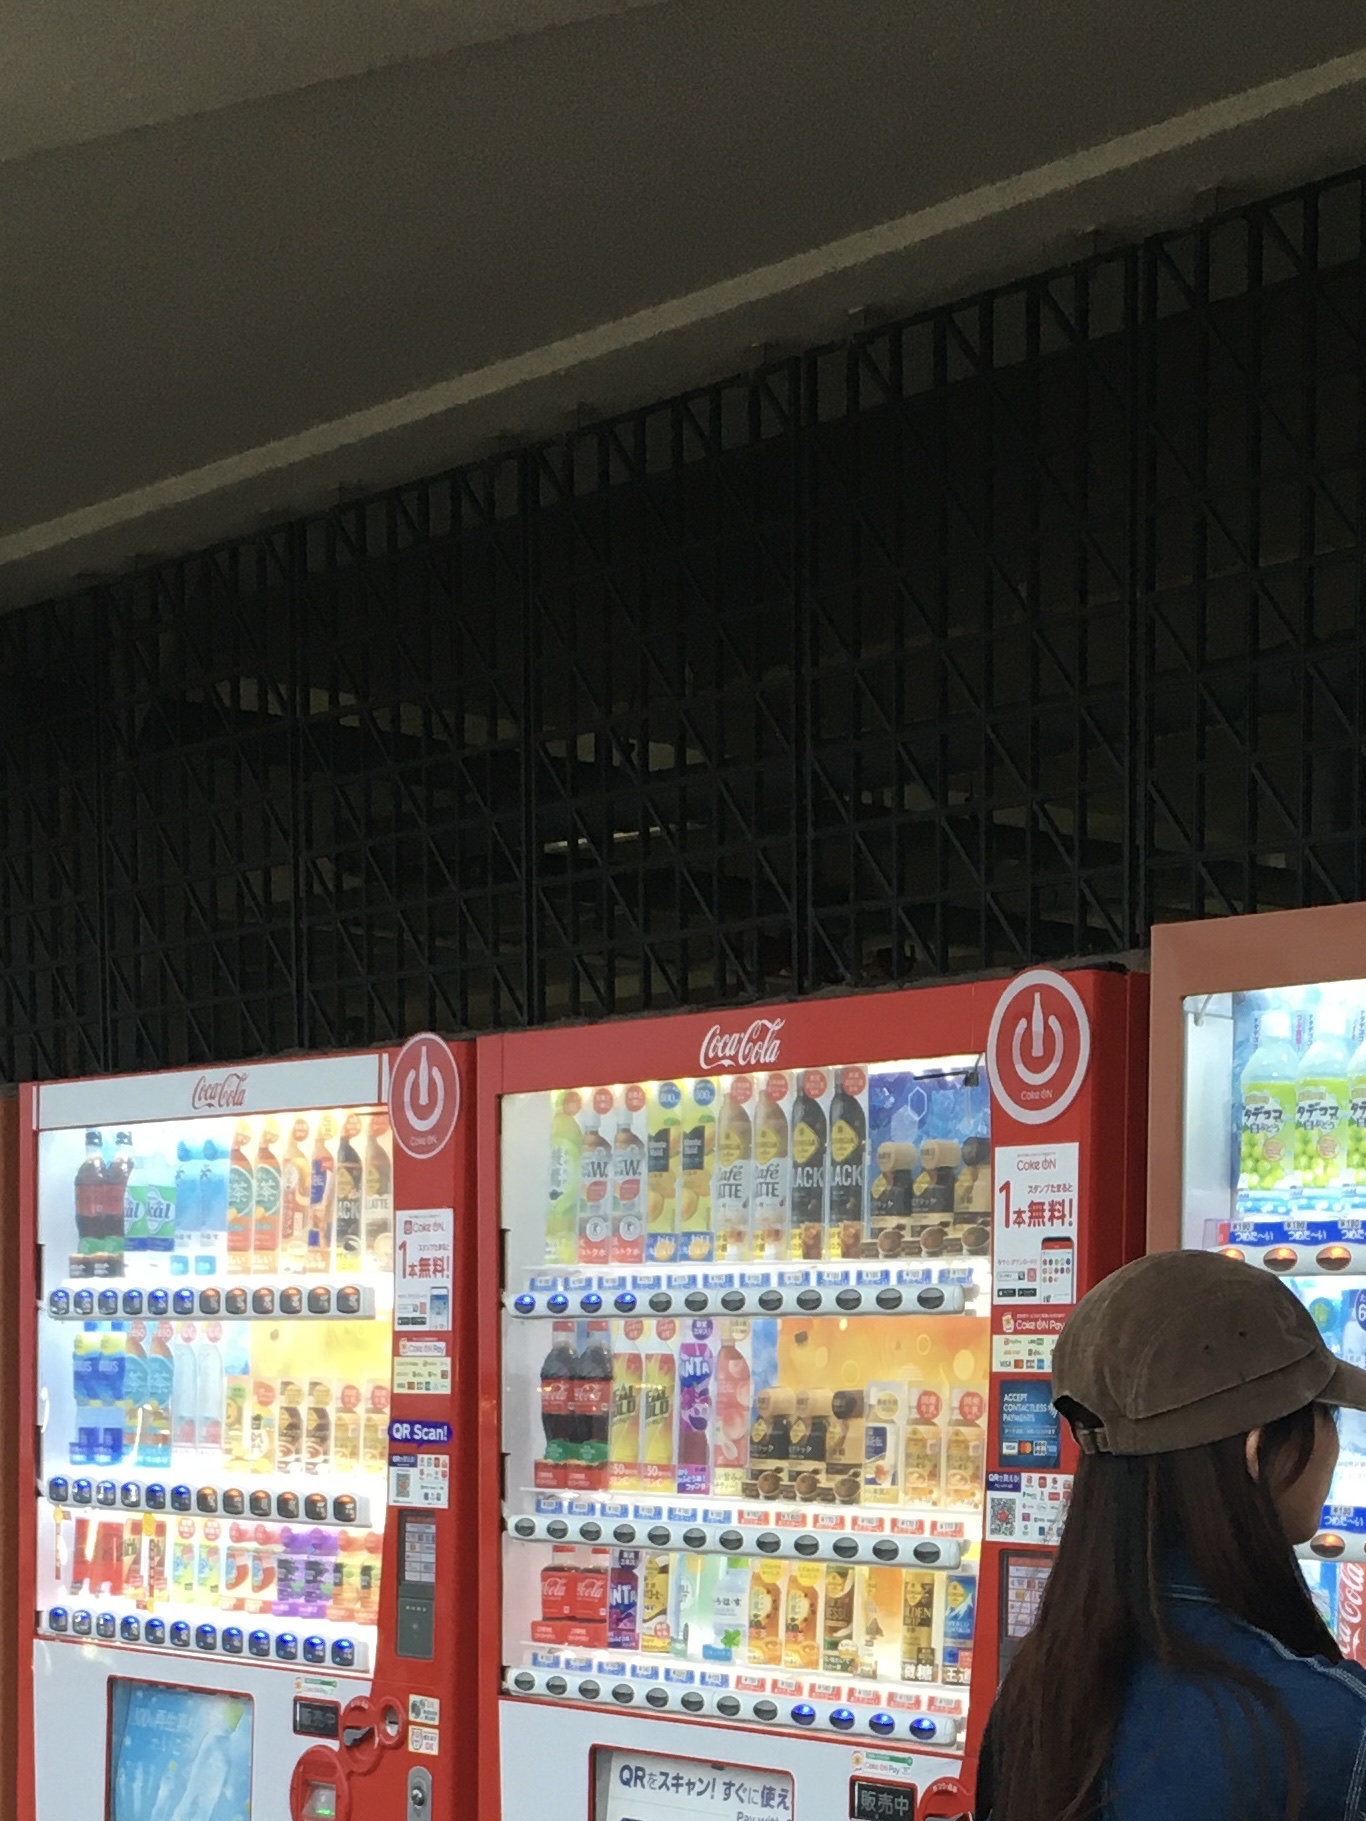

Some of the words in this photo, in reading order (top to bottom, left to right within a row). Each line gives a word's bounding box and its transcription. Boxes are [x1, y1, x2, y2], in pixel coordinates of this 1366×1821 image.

[700, 1018, 787, 1069] Coca-Cola
[192, 1073, 248, 1110] Coca-Cola
[1017, 1159, 1040, 1171] Coke
[1027, 1182, 1073, 1195] スタンプたまると
[999, 1180, 1074, 1229] 1本無料!
[392, 1423, 411, 1440] QR
[414, 1423, 448, 1442] Scan!
[619, 1764, 717, 1800] QRをスキャン!
[888, 1763, 901, 1775] Pay
[860, 1790, 910, 1818] 販売中
